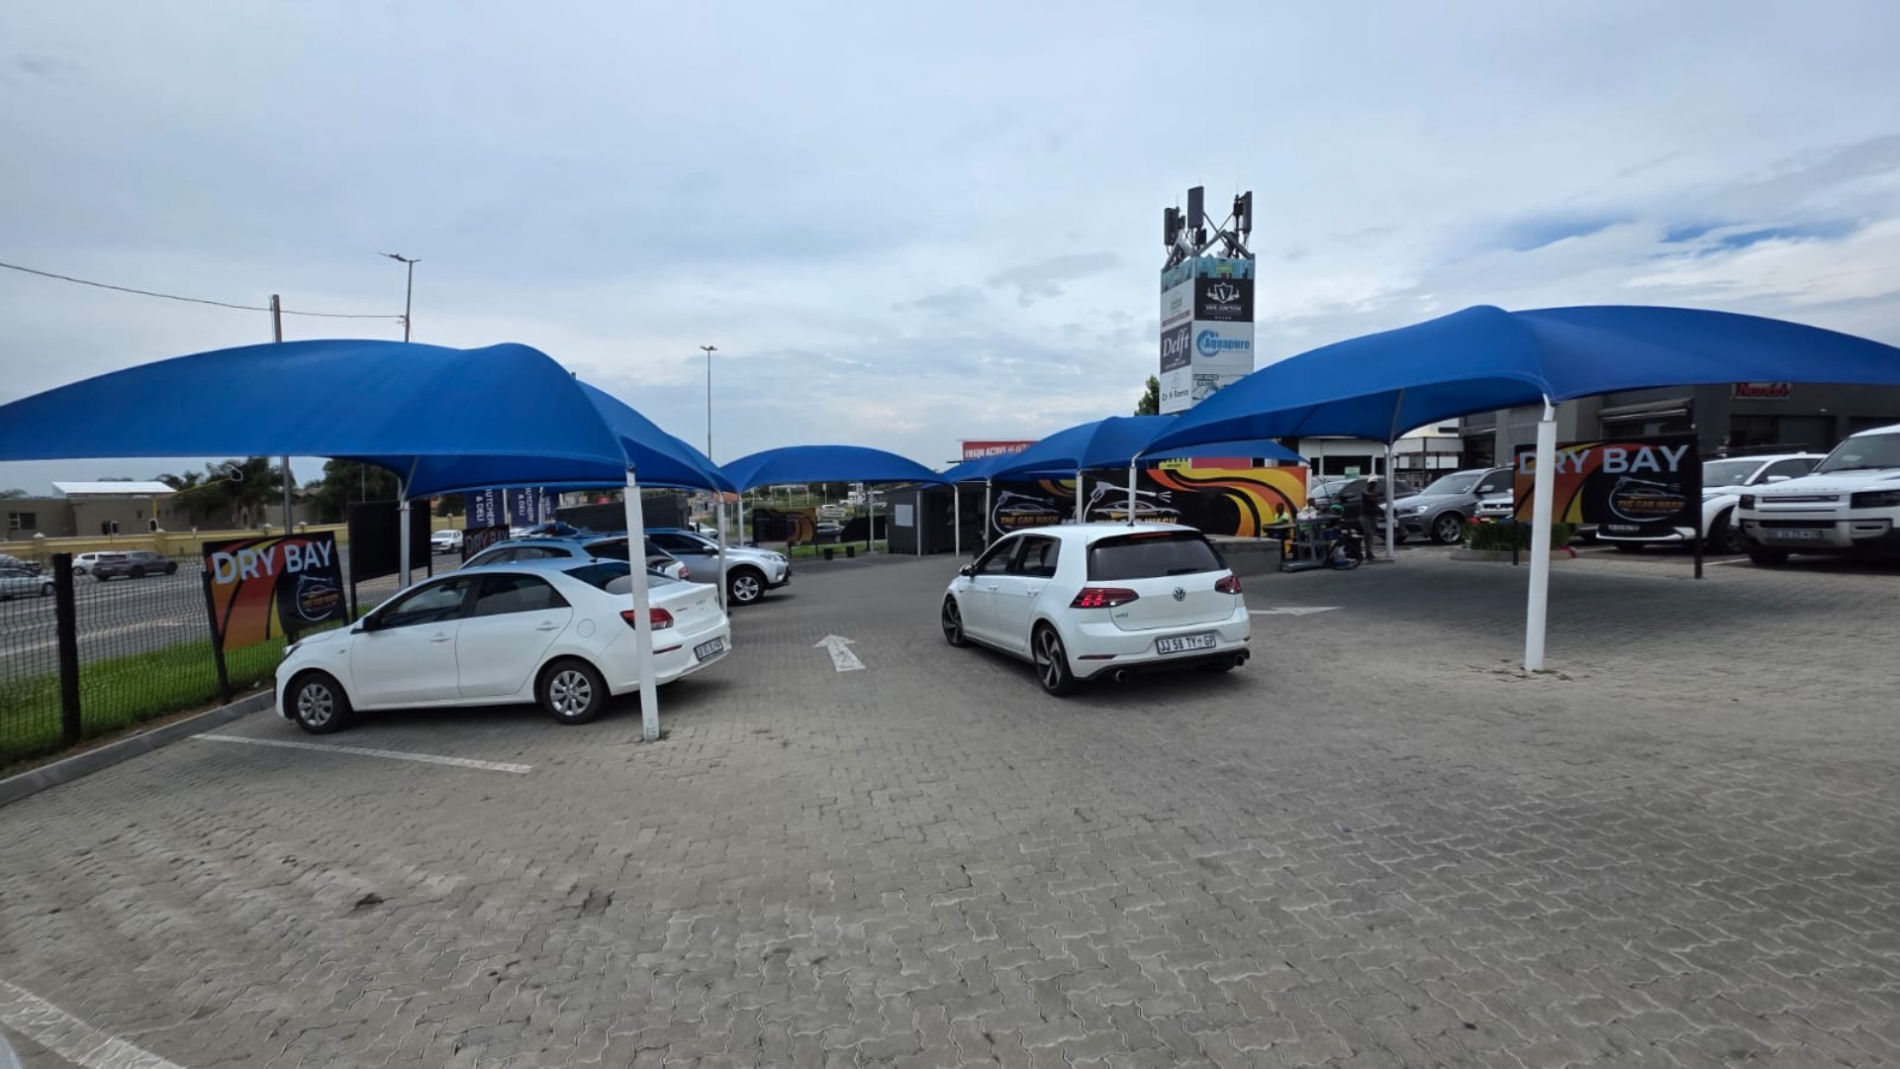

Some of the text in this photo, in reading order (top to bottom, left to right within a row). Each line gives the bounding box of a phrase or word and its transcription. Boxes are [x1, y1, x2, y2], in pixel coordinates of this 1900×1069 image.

[1162, 328, 1190, 361] Delft
[1203, 337, 1251, 350] Aquapure
[1519, 445, 1689, 475] DRY BAY
[476, 503, 486, 522] DELI
[211, 540, 332, 585] DRY BAY
